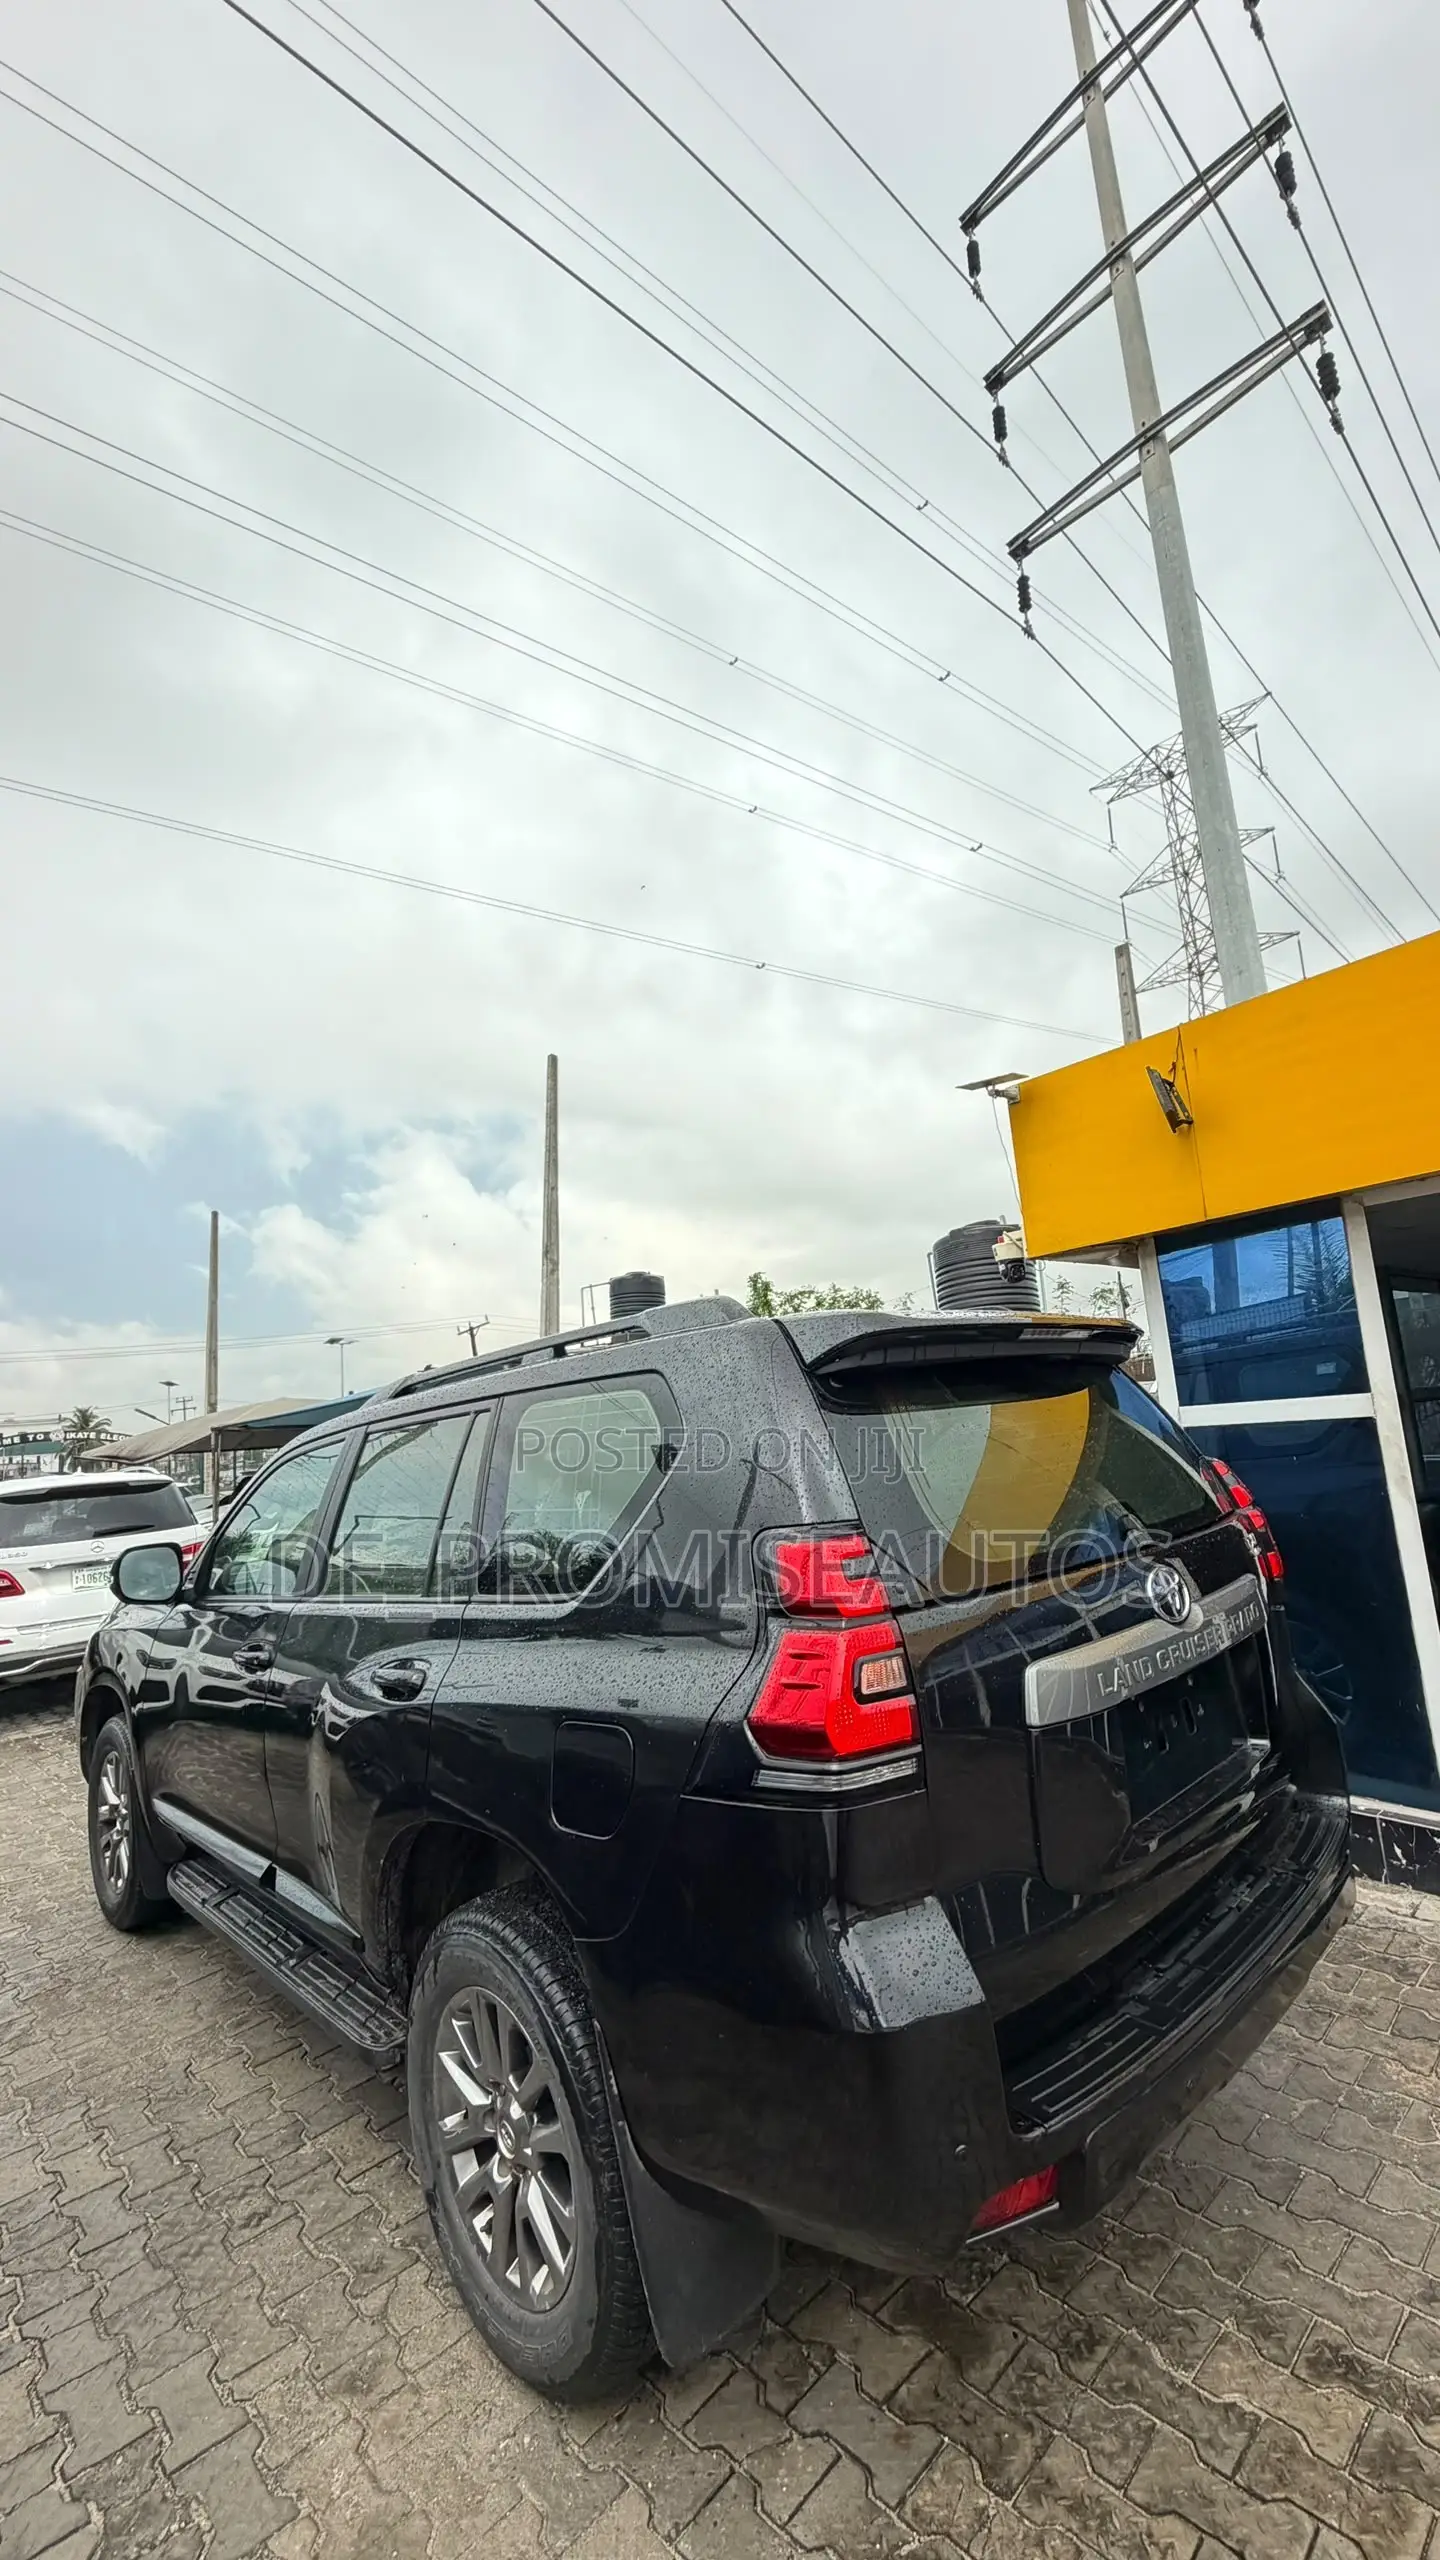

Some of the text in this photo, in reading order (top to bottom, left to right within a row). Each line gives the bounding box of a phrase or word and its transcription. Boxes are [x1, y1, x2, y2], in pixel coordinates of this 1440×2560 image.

[27, 1433, 45, 1441] TO
[66, 1431, 97, 1439] IKATE
[1097, 1656, 1155, 1697] LAND
[1156, 1621, 1227, 1673] CRUISER
